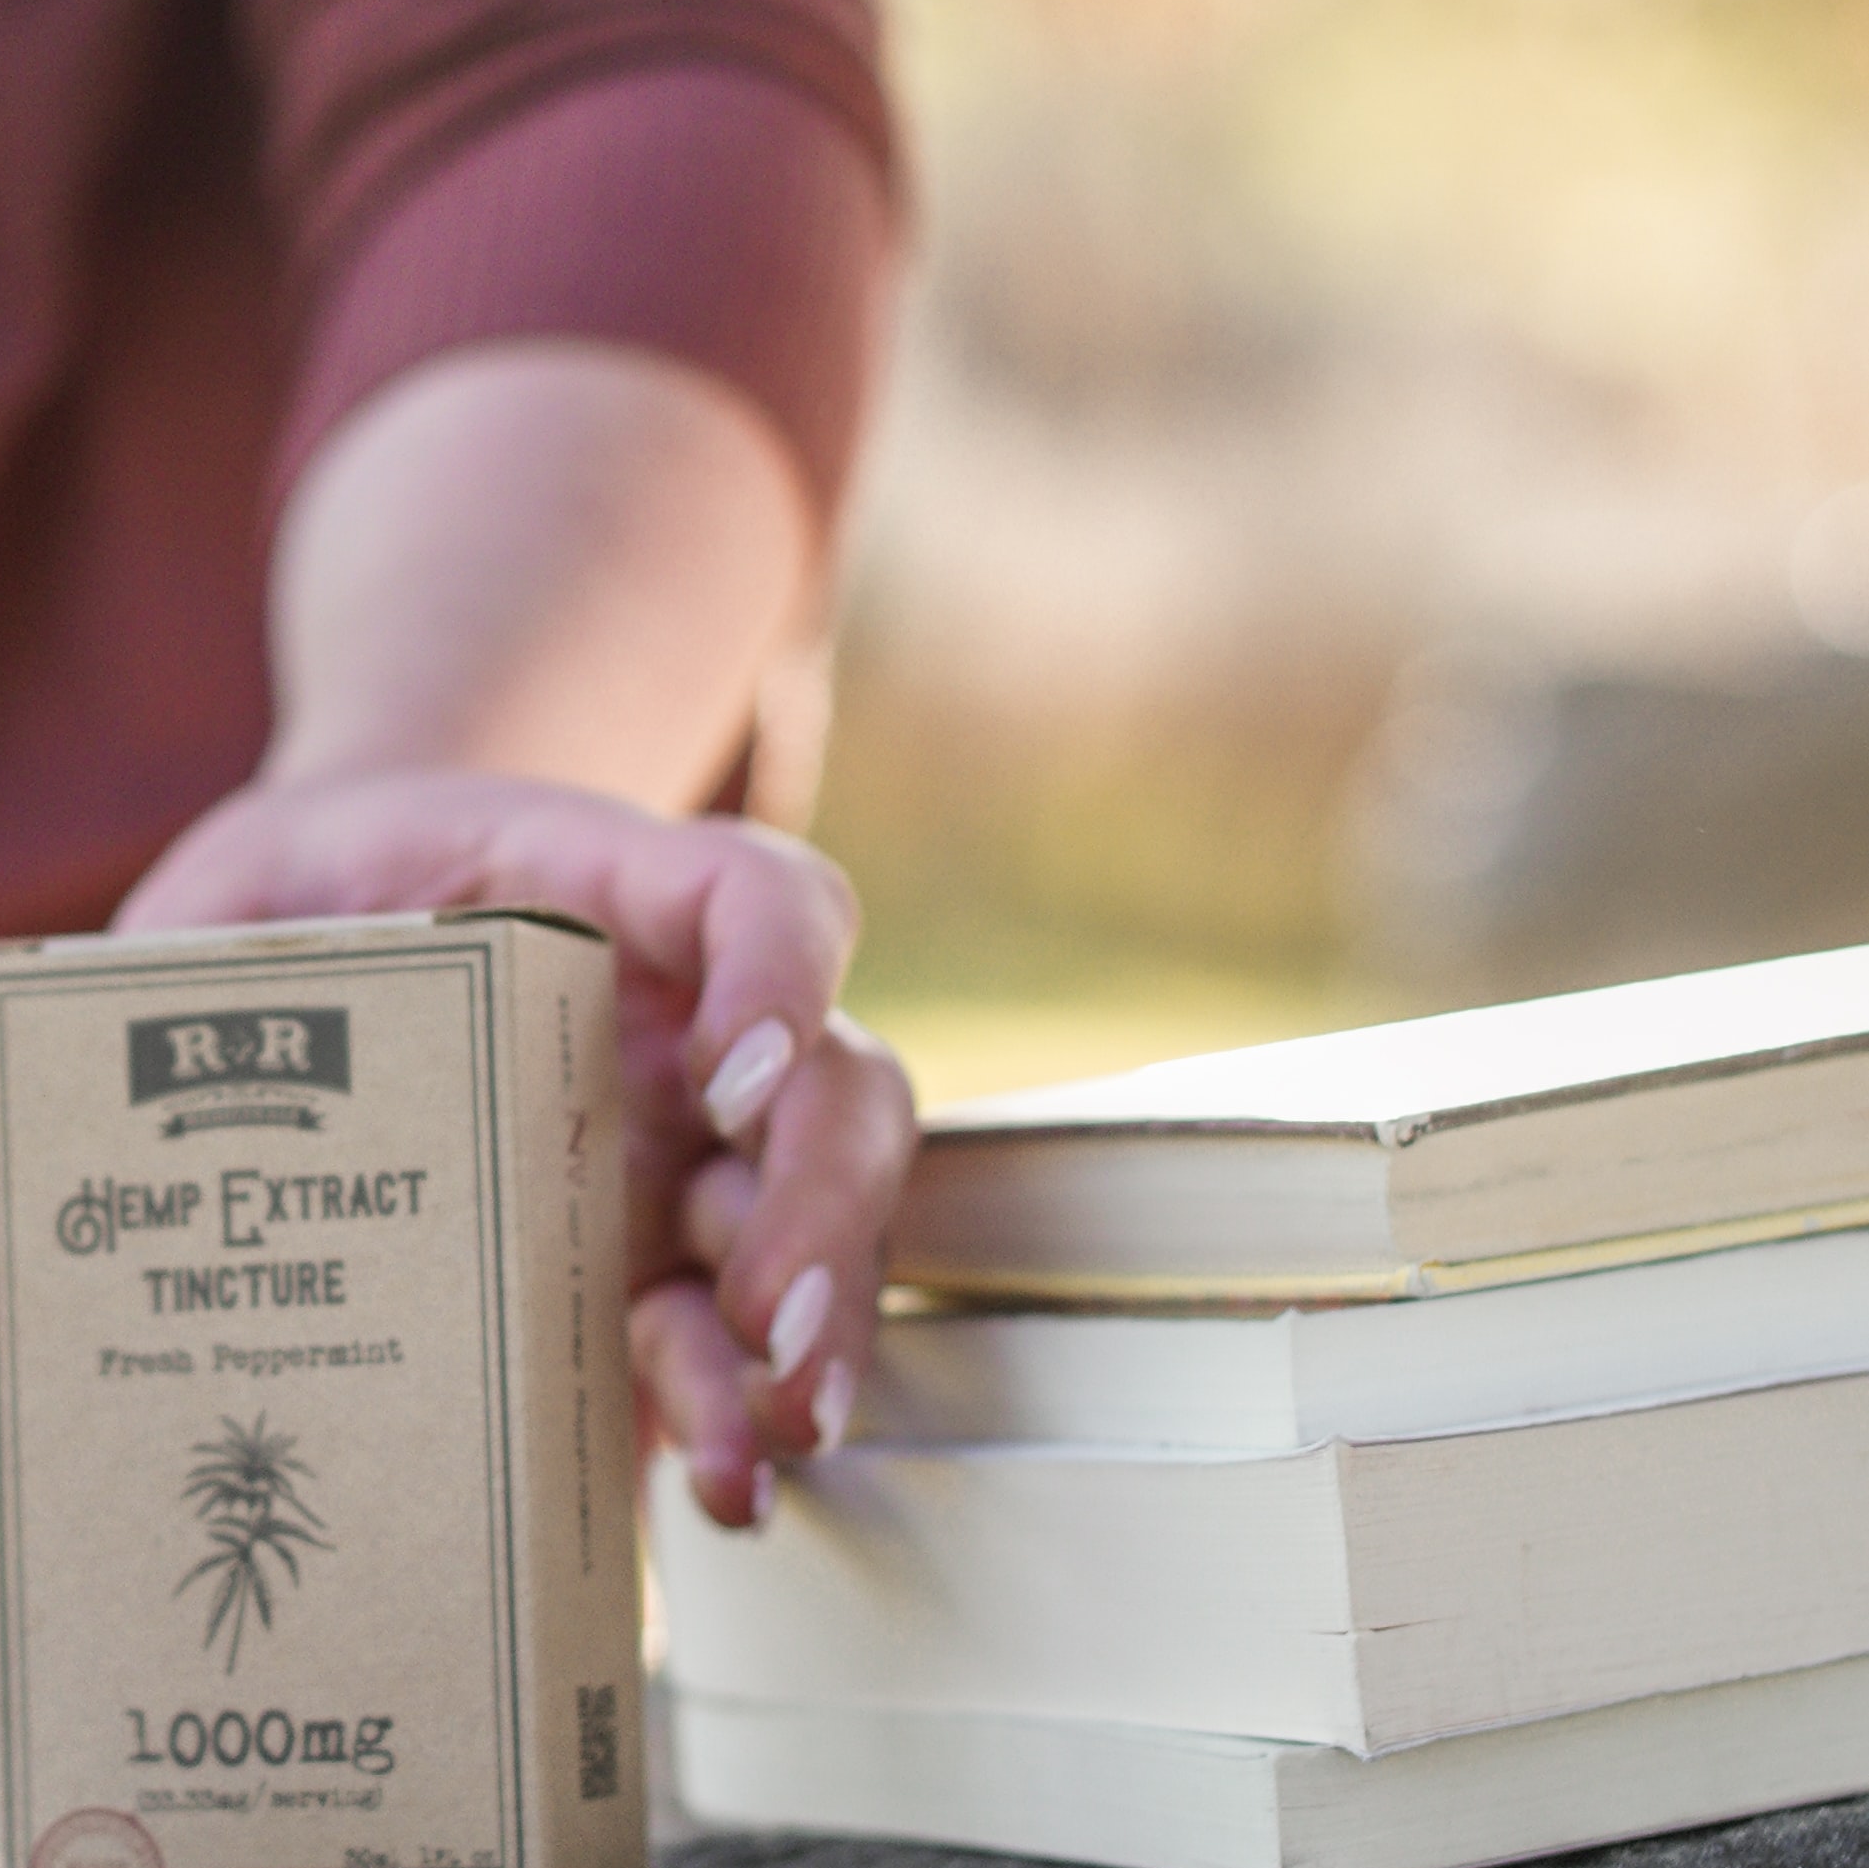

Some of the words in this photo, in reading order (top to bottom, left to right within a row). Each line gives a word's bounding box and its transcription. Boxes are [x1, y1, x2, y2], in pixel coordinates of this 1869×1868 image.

[219, 1168, 429, 1249] EXTRACT
[143, 1260, 347, 1315] TINCTURE
[98, 1346, 194, 1378] Fresh
[212, 1337, 405, 1379] Peppermint
[125, 1706, 397, 1776] 1000mg
